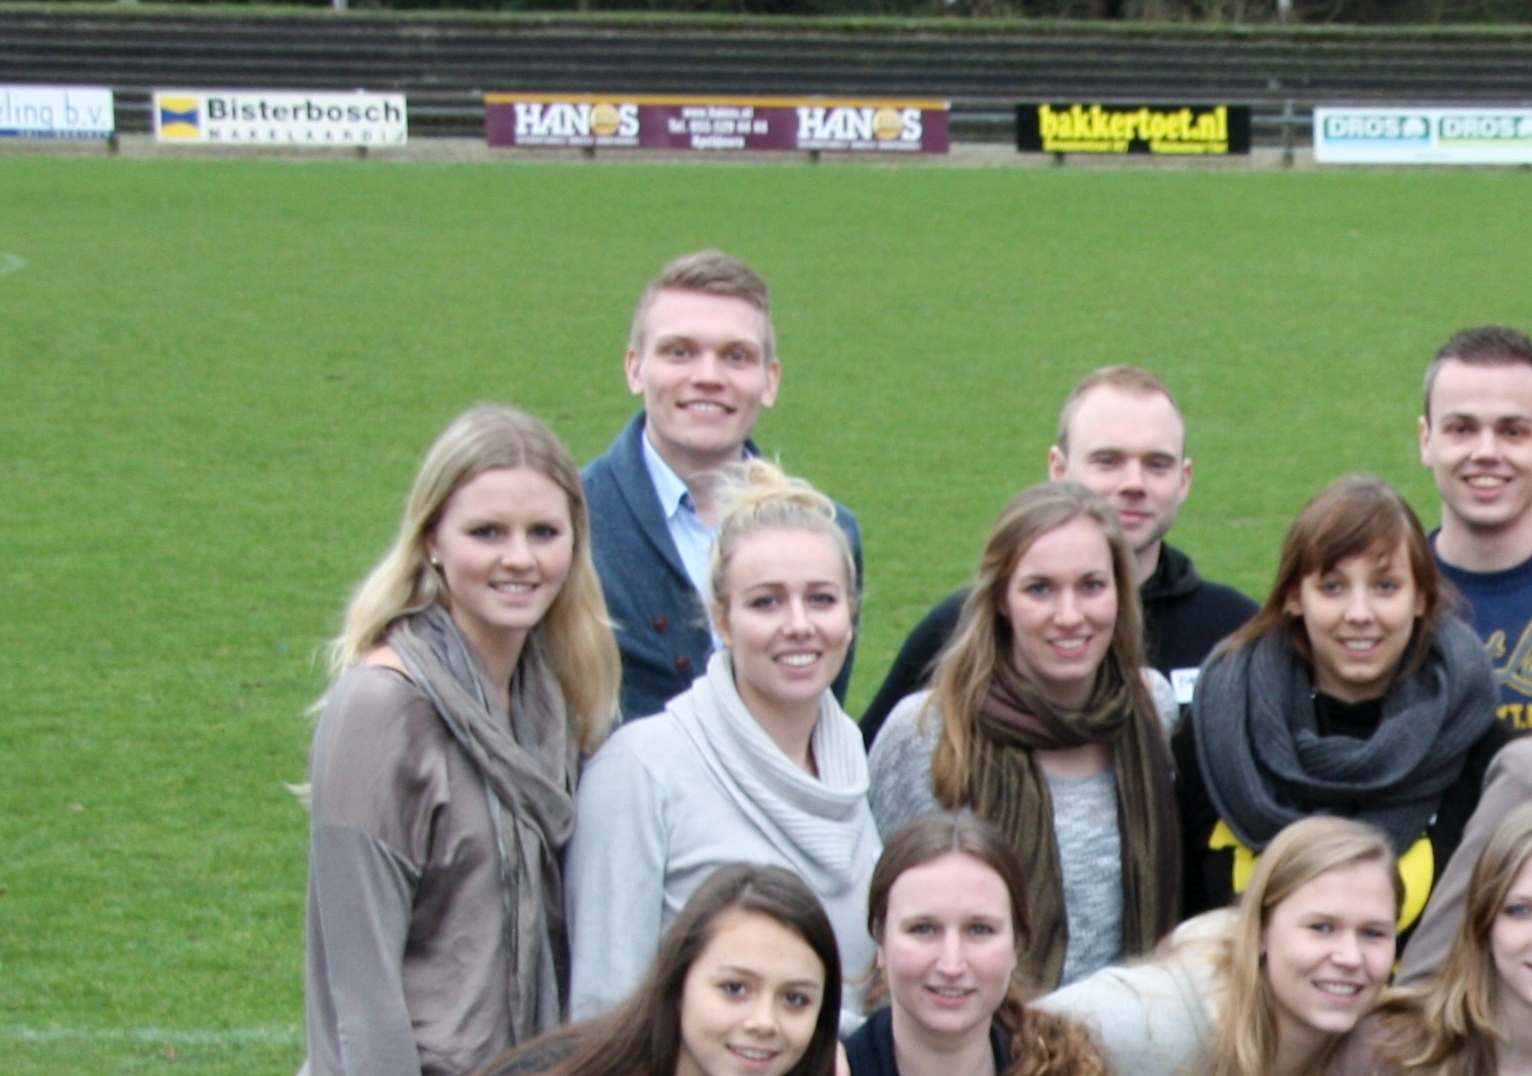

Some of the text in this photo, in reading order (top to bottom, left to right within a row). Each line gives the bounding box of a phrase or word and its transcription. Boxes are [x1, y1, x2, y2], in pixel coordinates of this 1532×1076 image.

[0, 88, 54, 130] ling
[207, 99, 401, 121] Bisterbosch
[514, 102, 640, 136] HANOS
[797, 106, 922, 142] HANOS
[1039, 103, 1228, 140] bakkertoet.nl
[1327, 116, 1401, 138] DROS
[1442, 117, 1516, 138] DROS
